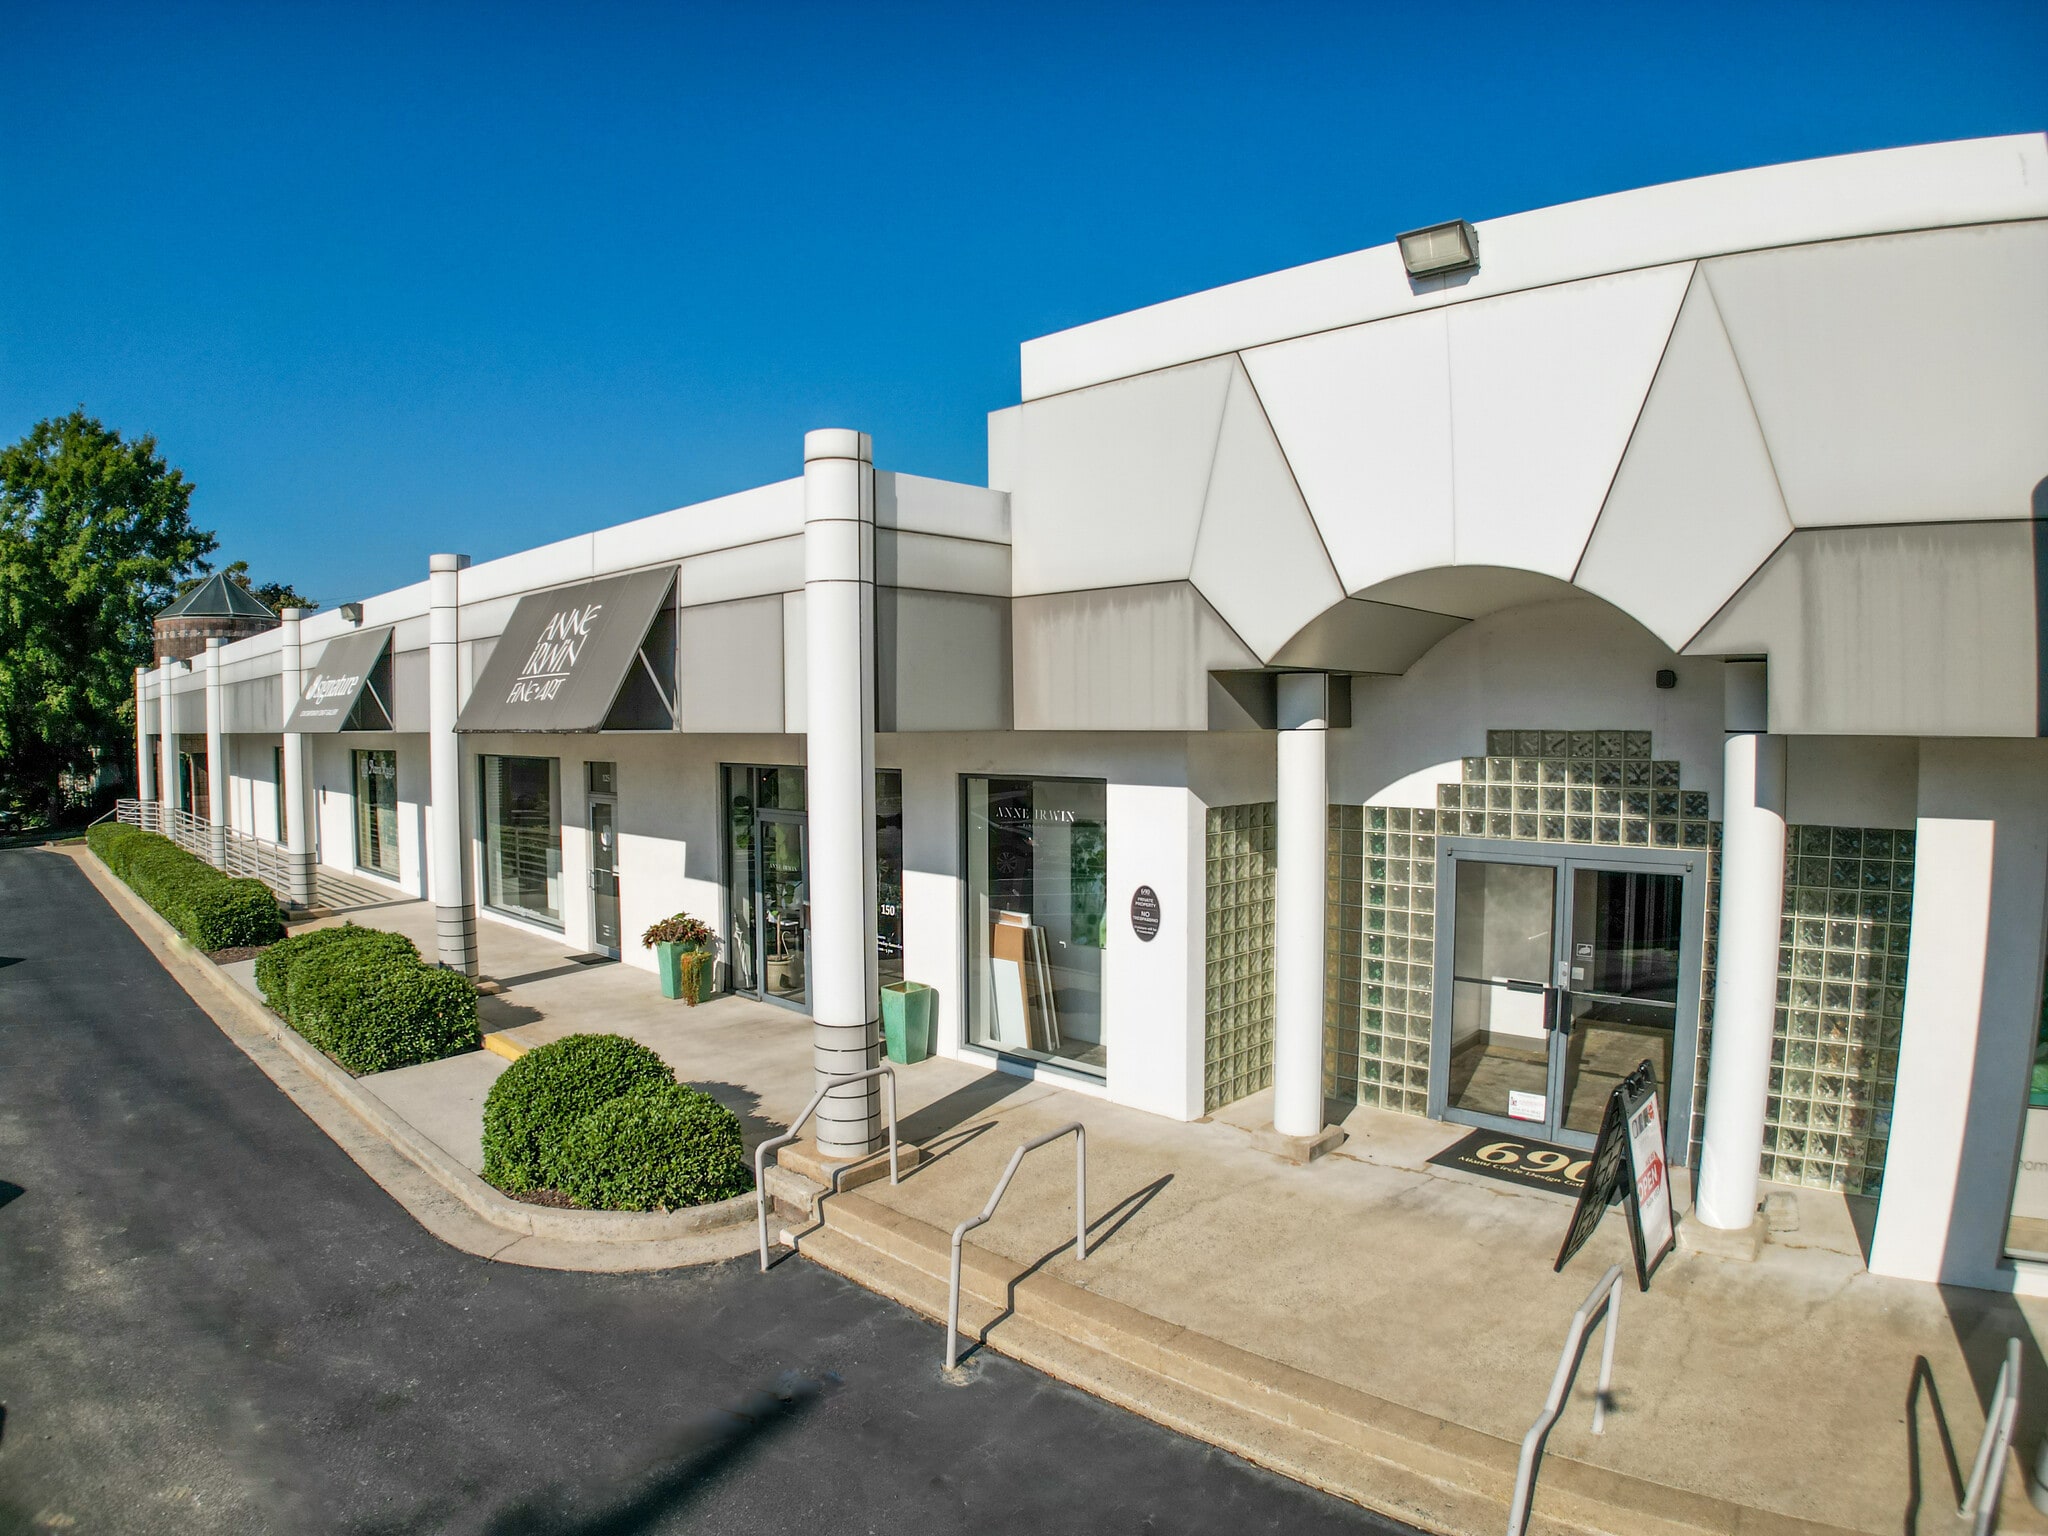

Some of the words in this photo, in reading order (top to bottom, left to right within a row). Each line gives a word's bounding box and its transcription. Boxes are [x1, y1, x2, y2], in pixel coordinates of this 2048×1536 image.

[537, 604, 602, 643] ANNE
[522, 635, 588, 675] IRWIN
[996, 806, 1030, 819] ANNE
[1035, 809, 1076, 823] IRWIN
[881, 904, 896, 916] 150
[1492, 1163, 1523, 1174] Circle
[1525, 1171, 1561, 1184] Design
[1638, 1164, 1658, 1199] OPEN
